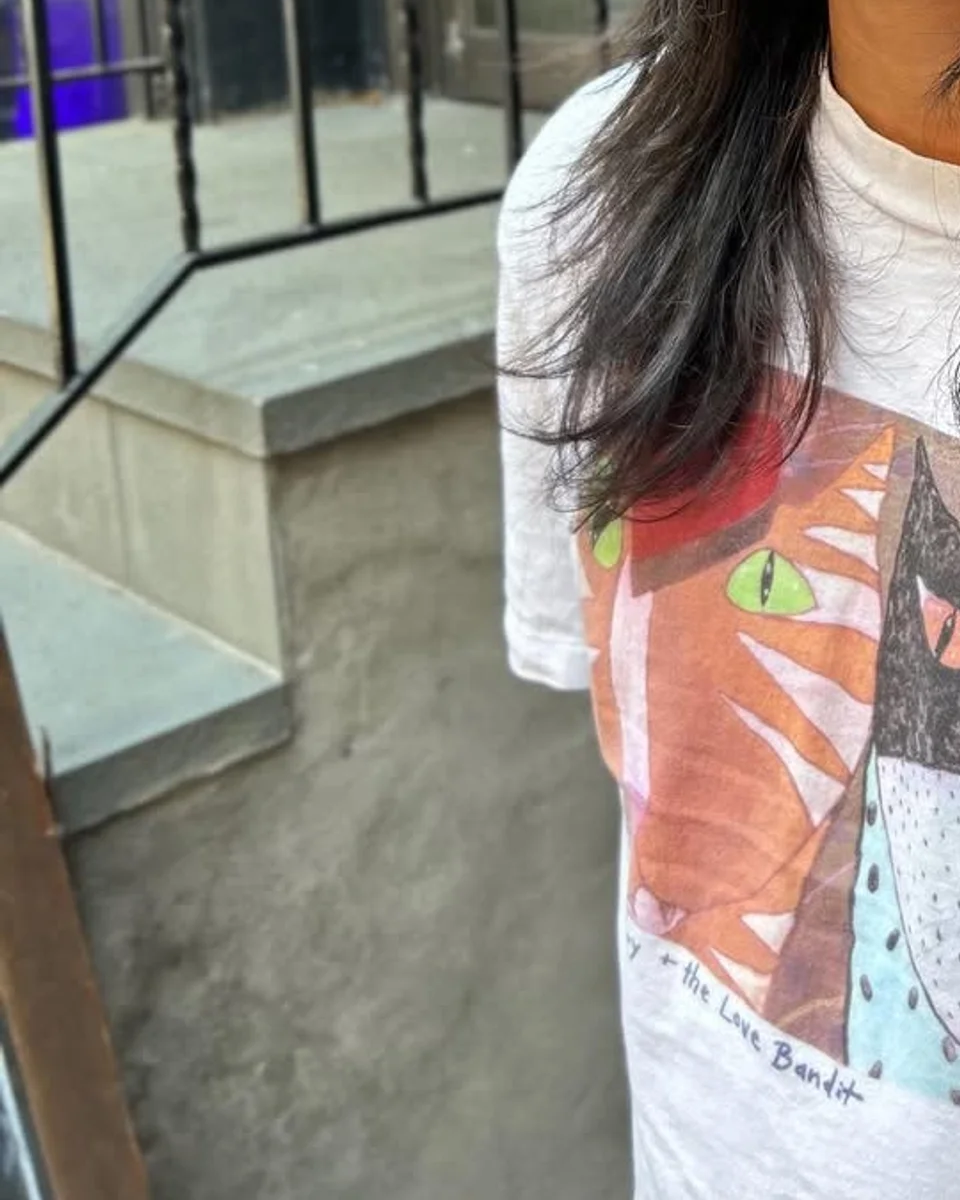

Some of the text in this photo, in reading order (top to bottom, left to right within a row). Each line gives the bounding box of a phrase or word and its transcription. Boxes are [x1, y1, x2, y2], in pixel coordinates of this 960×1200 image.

[681, 960, 711, 1005] the
[719, 995, 762, 1052] Love
[769, 1038, 865, 1104] Bandit
